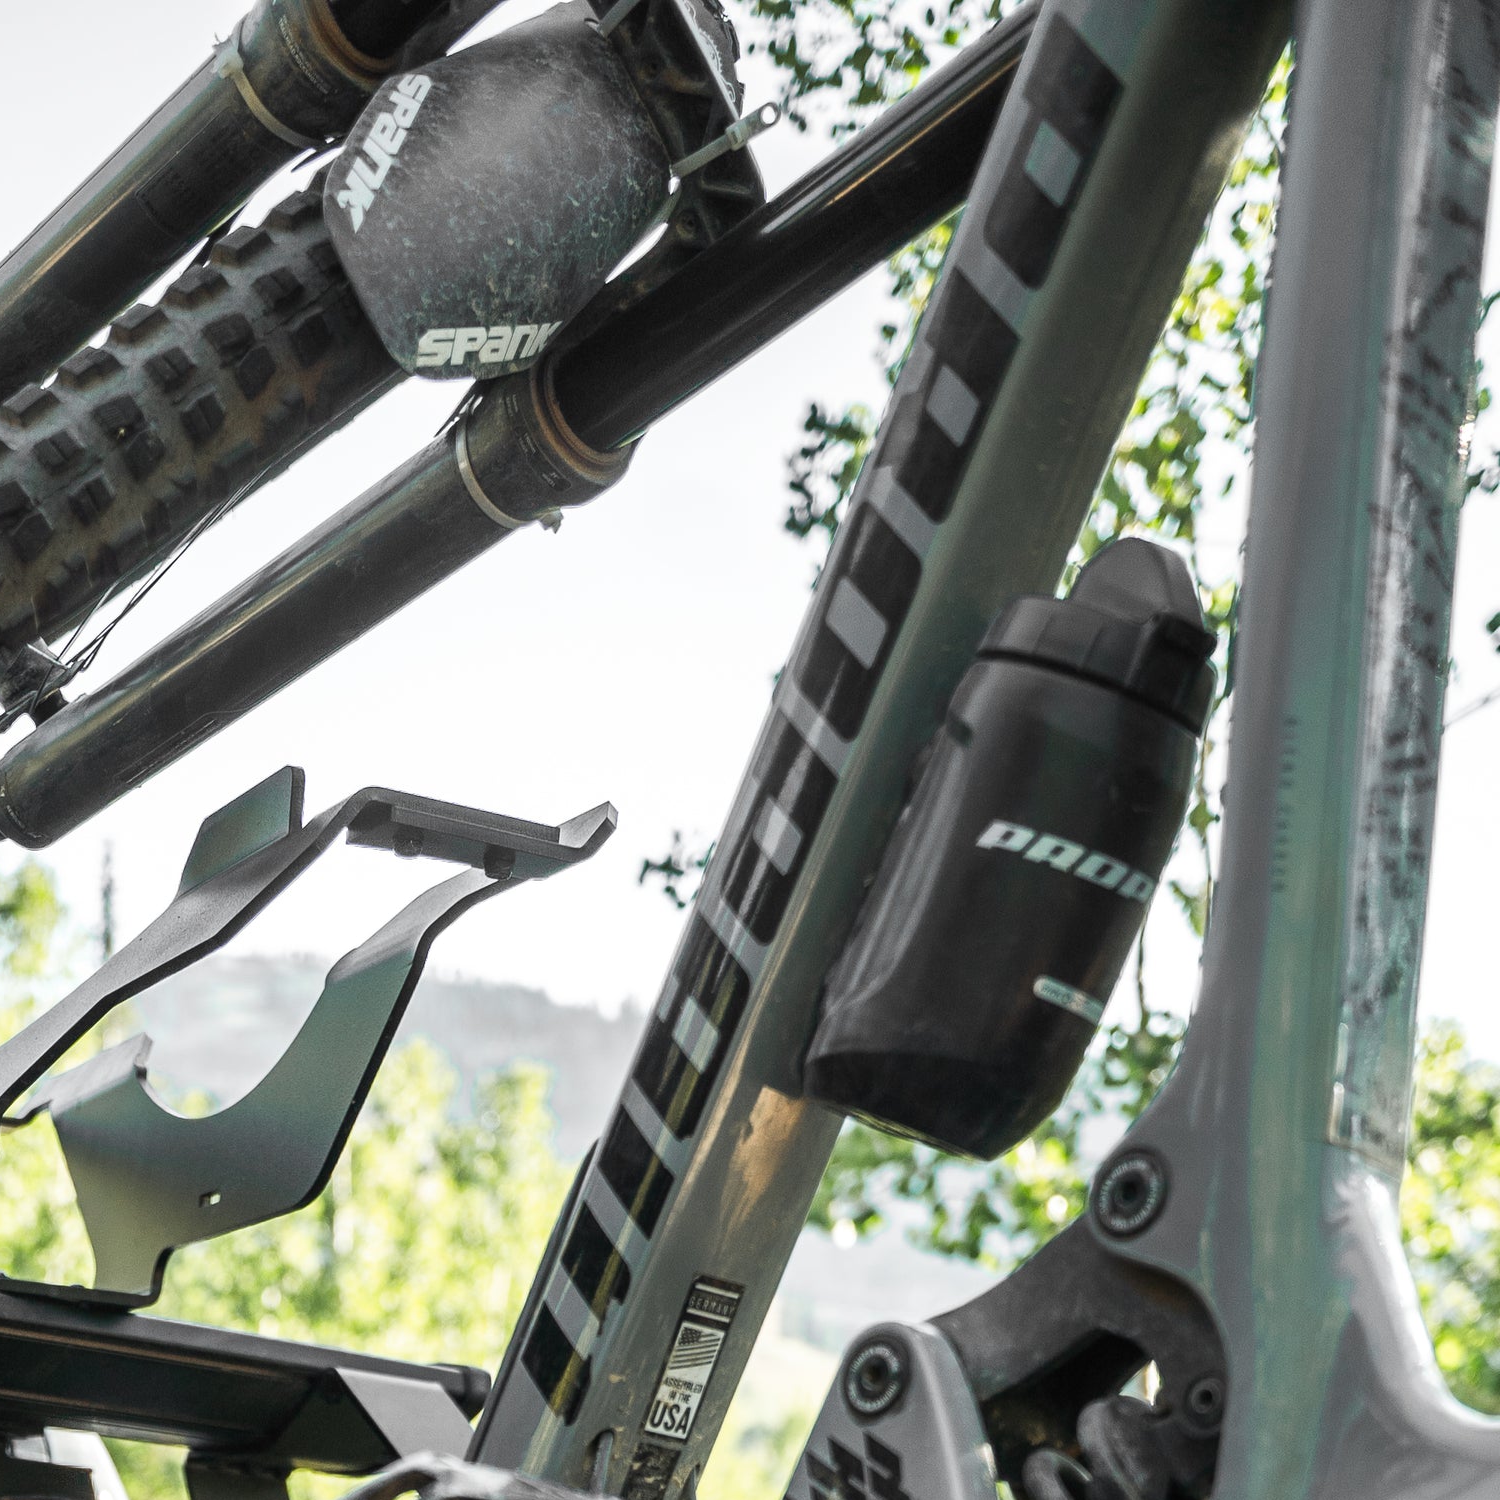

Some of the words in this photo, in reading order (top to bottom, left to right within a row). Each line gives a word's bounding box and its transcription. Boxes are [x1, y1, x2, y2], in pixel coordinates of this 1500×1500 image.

[689, 1295, 736, 1318] GERMANY
[663, 1376, 704, 1394] ASSEMBLED
[668, 1389, 677, 1400] IN
[678, 1391, 691, 1403] THE
[650, 1401, 692, 1435] USA
